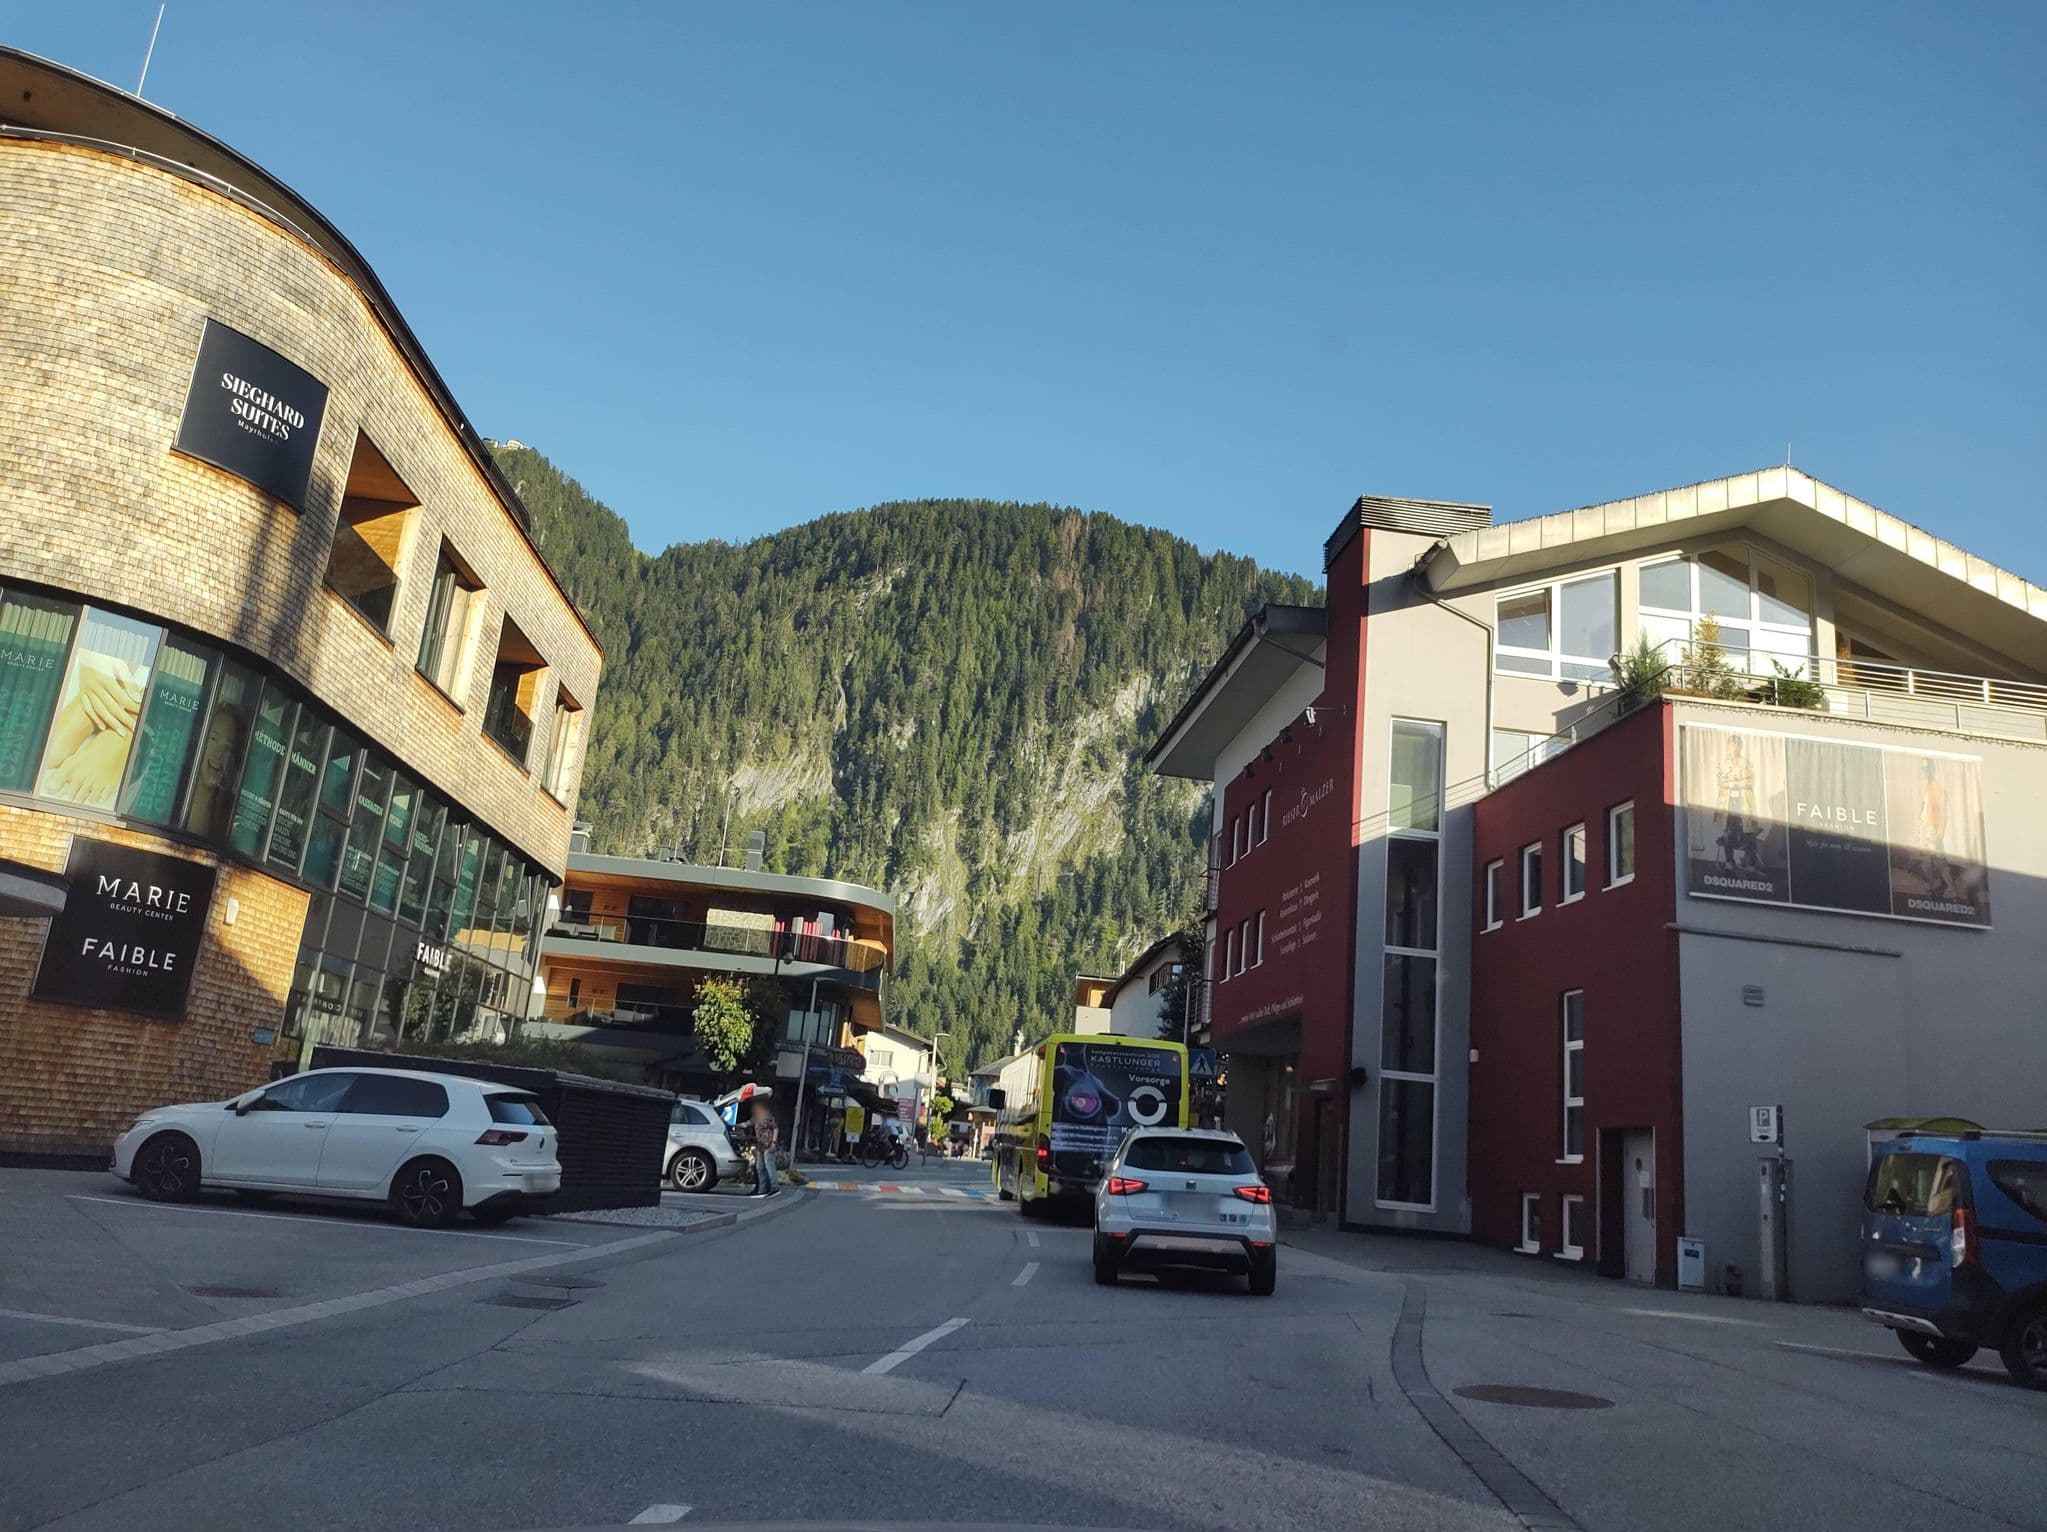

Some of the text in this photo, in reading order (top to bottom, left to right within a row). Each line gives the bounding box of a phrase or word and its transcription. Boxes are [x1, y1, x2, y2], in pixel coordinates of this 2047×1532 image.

[221, 372, 305, 430] SIEGHARD
[230, 398, 290, 441] SUITES
[1, 648, 55, 669] MARIE
[160, 689, 200, 711] MARIE
[1796, 802, 1877, 825] FAIBLE
[96, 874, 191, 914] MARIE
[1703, 874, 1773, 893] DSQUARED2
[110, 902, 174, 921] BEAUTY CENTER
[1907, 898, 1977, 915] DSQUARED2
[82, 937, 176, 971] FAIBLE
[107, 964, 149, 977] FASHION
[1090, 1054, 1161, 1068] KASTLUNGER
[1128, 1073, 1171, 1087] Vorsorge
